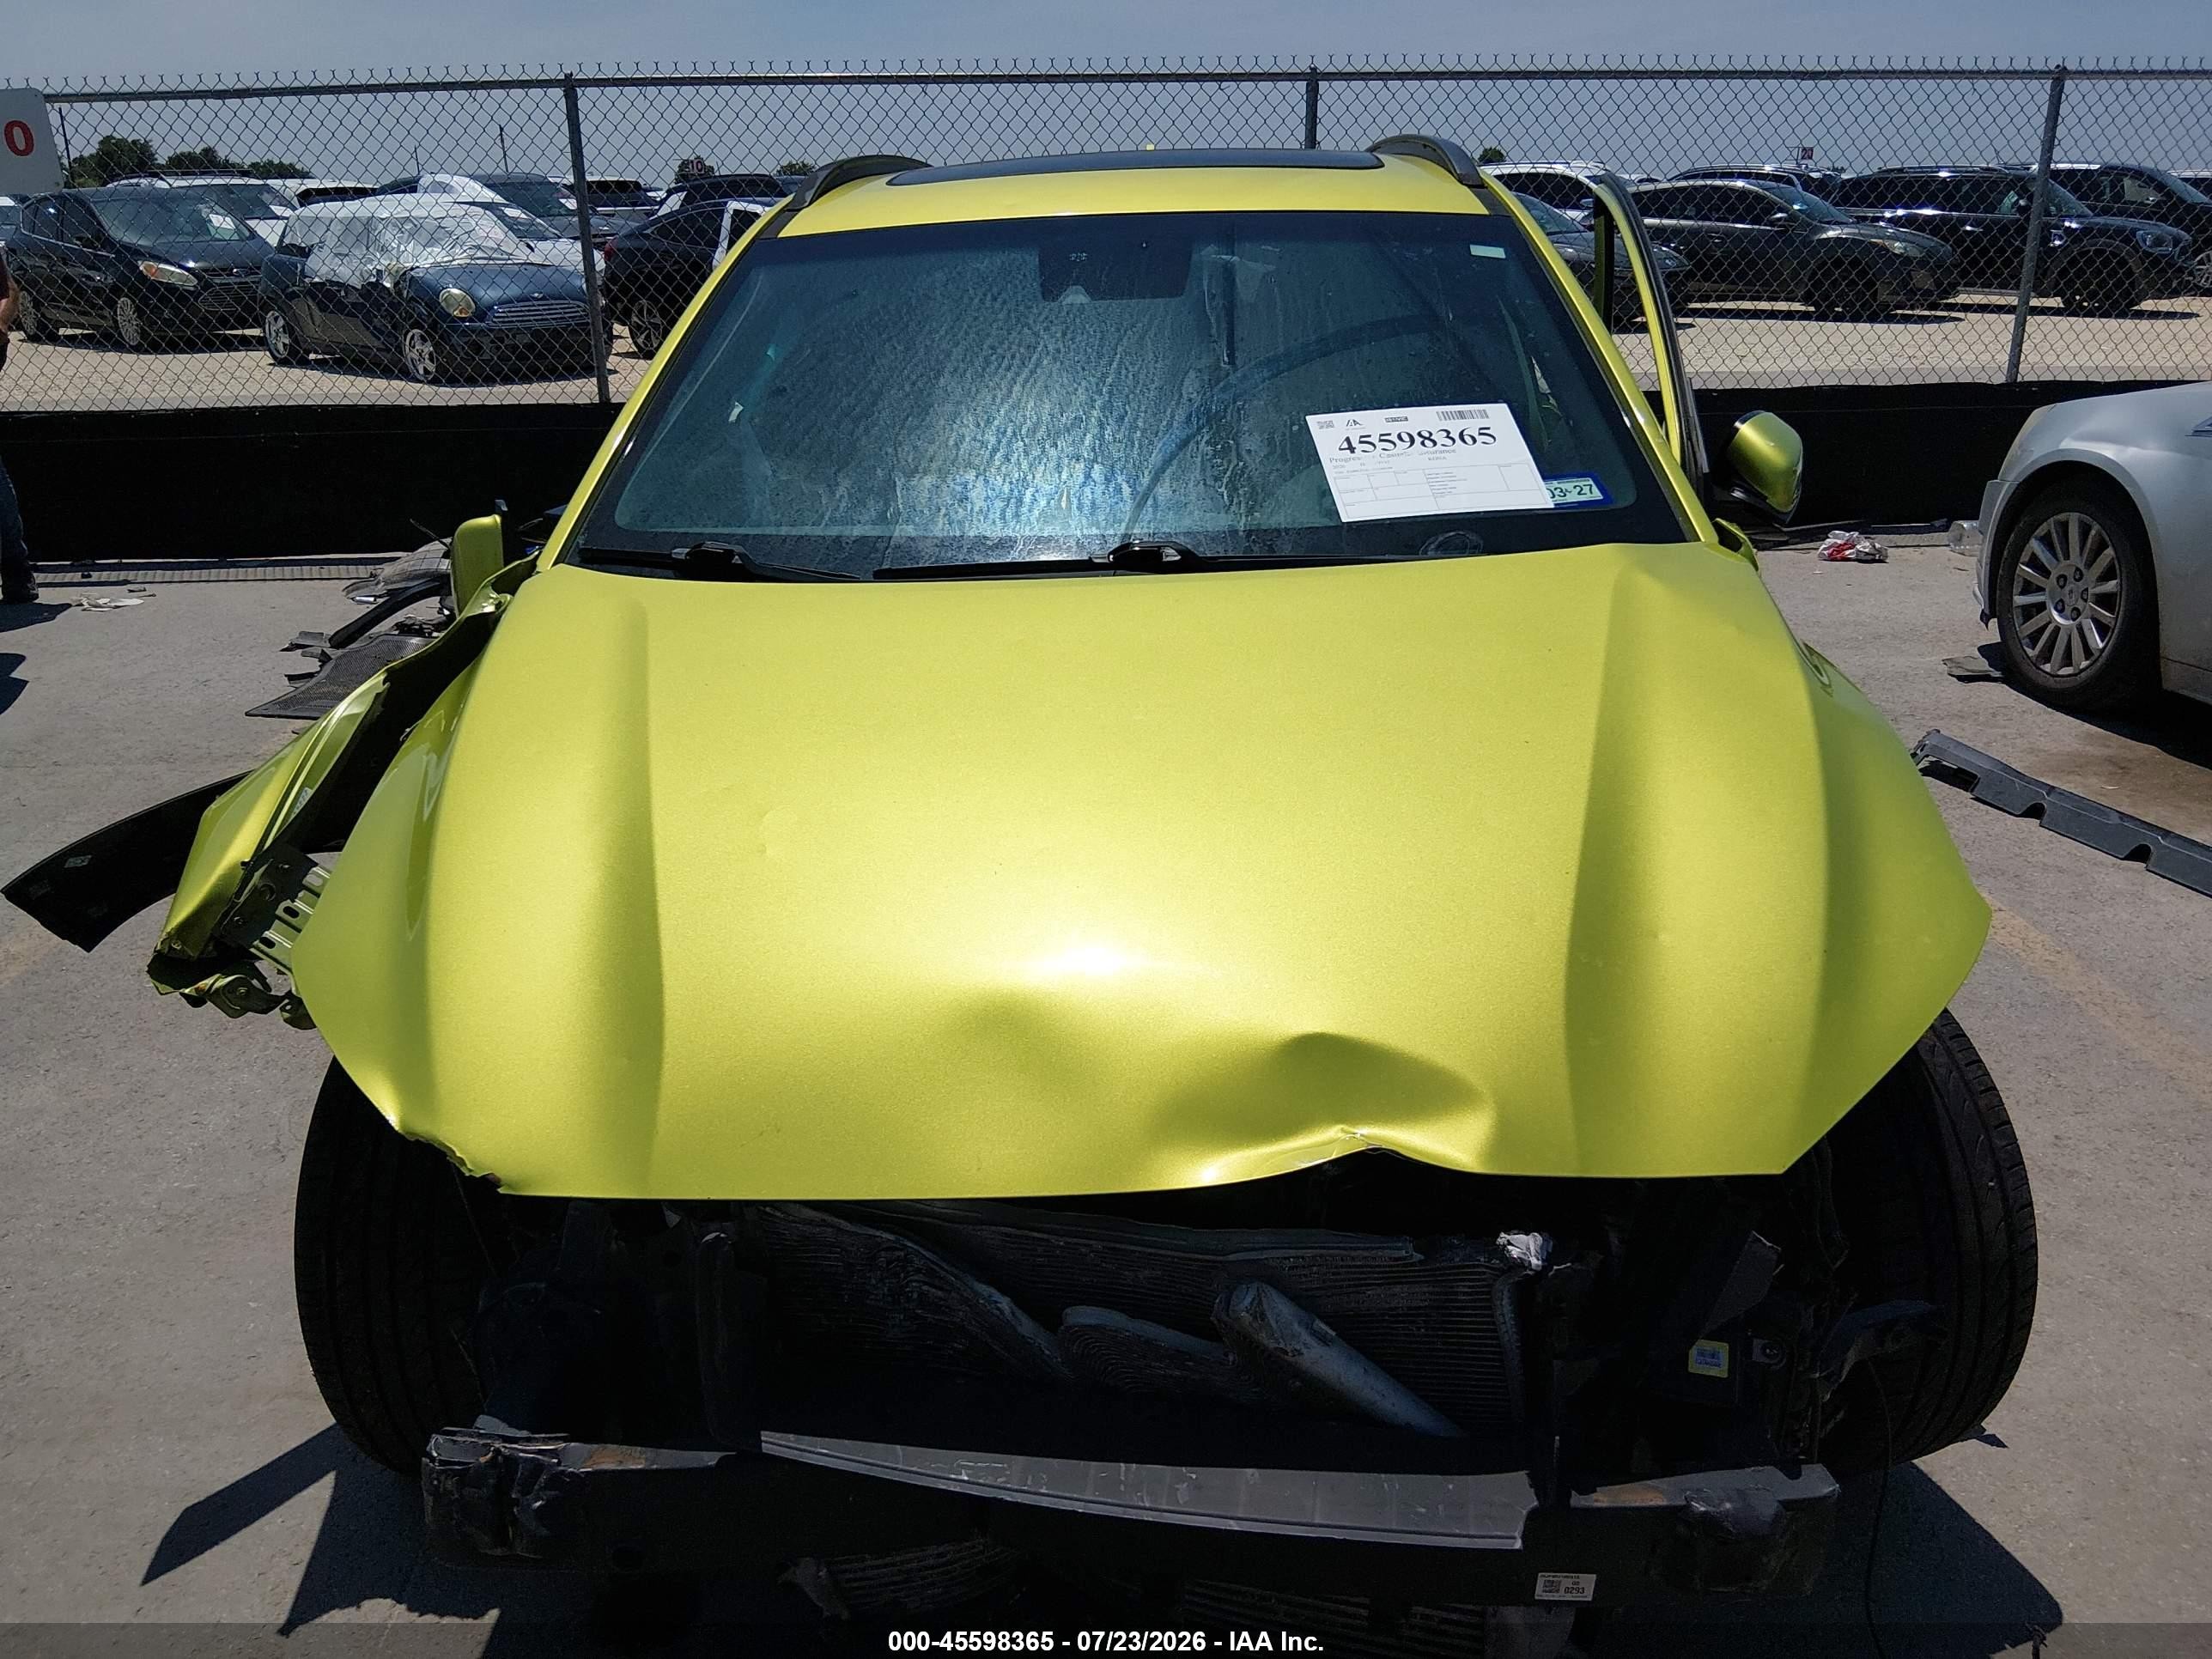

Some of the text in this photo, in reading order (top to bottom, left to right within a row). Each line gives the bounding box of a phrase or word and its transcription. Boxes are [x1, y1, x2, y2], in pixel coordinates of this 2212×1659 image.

[4, 120, 34, 156] 0
[1338, 427, 1497, 454] 45598365
[1573, 484, 1593, 495] 27
